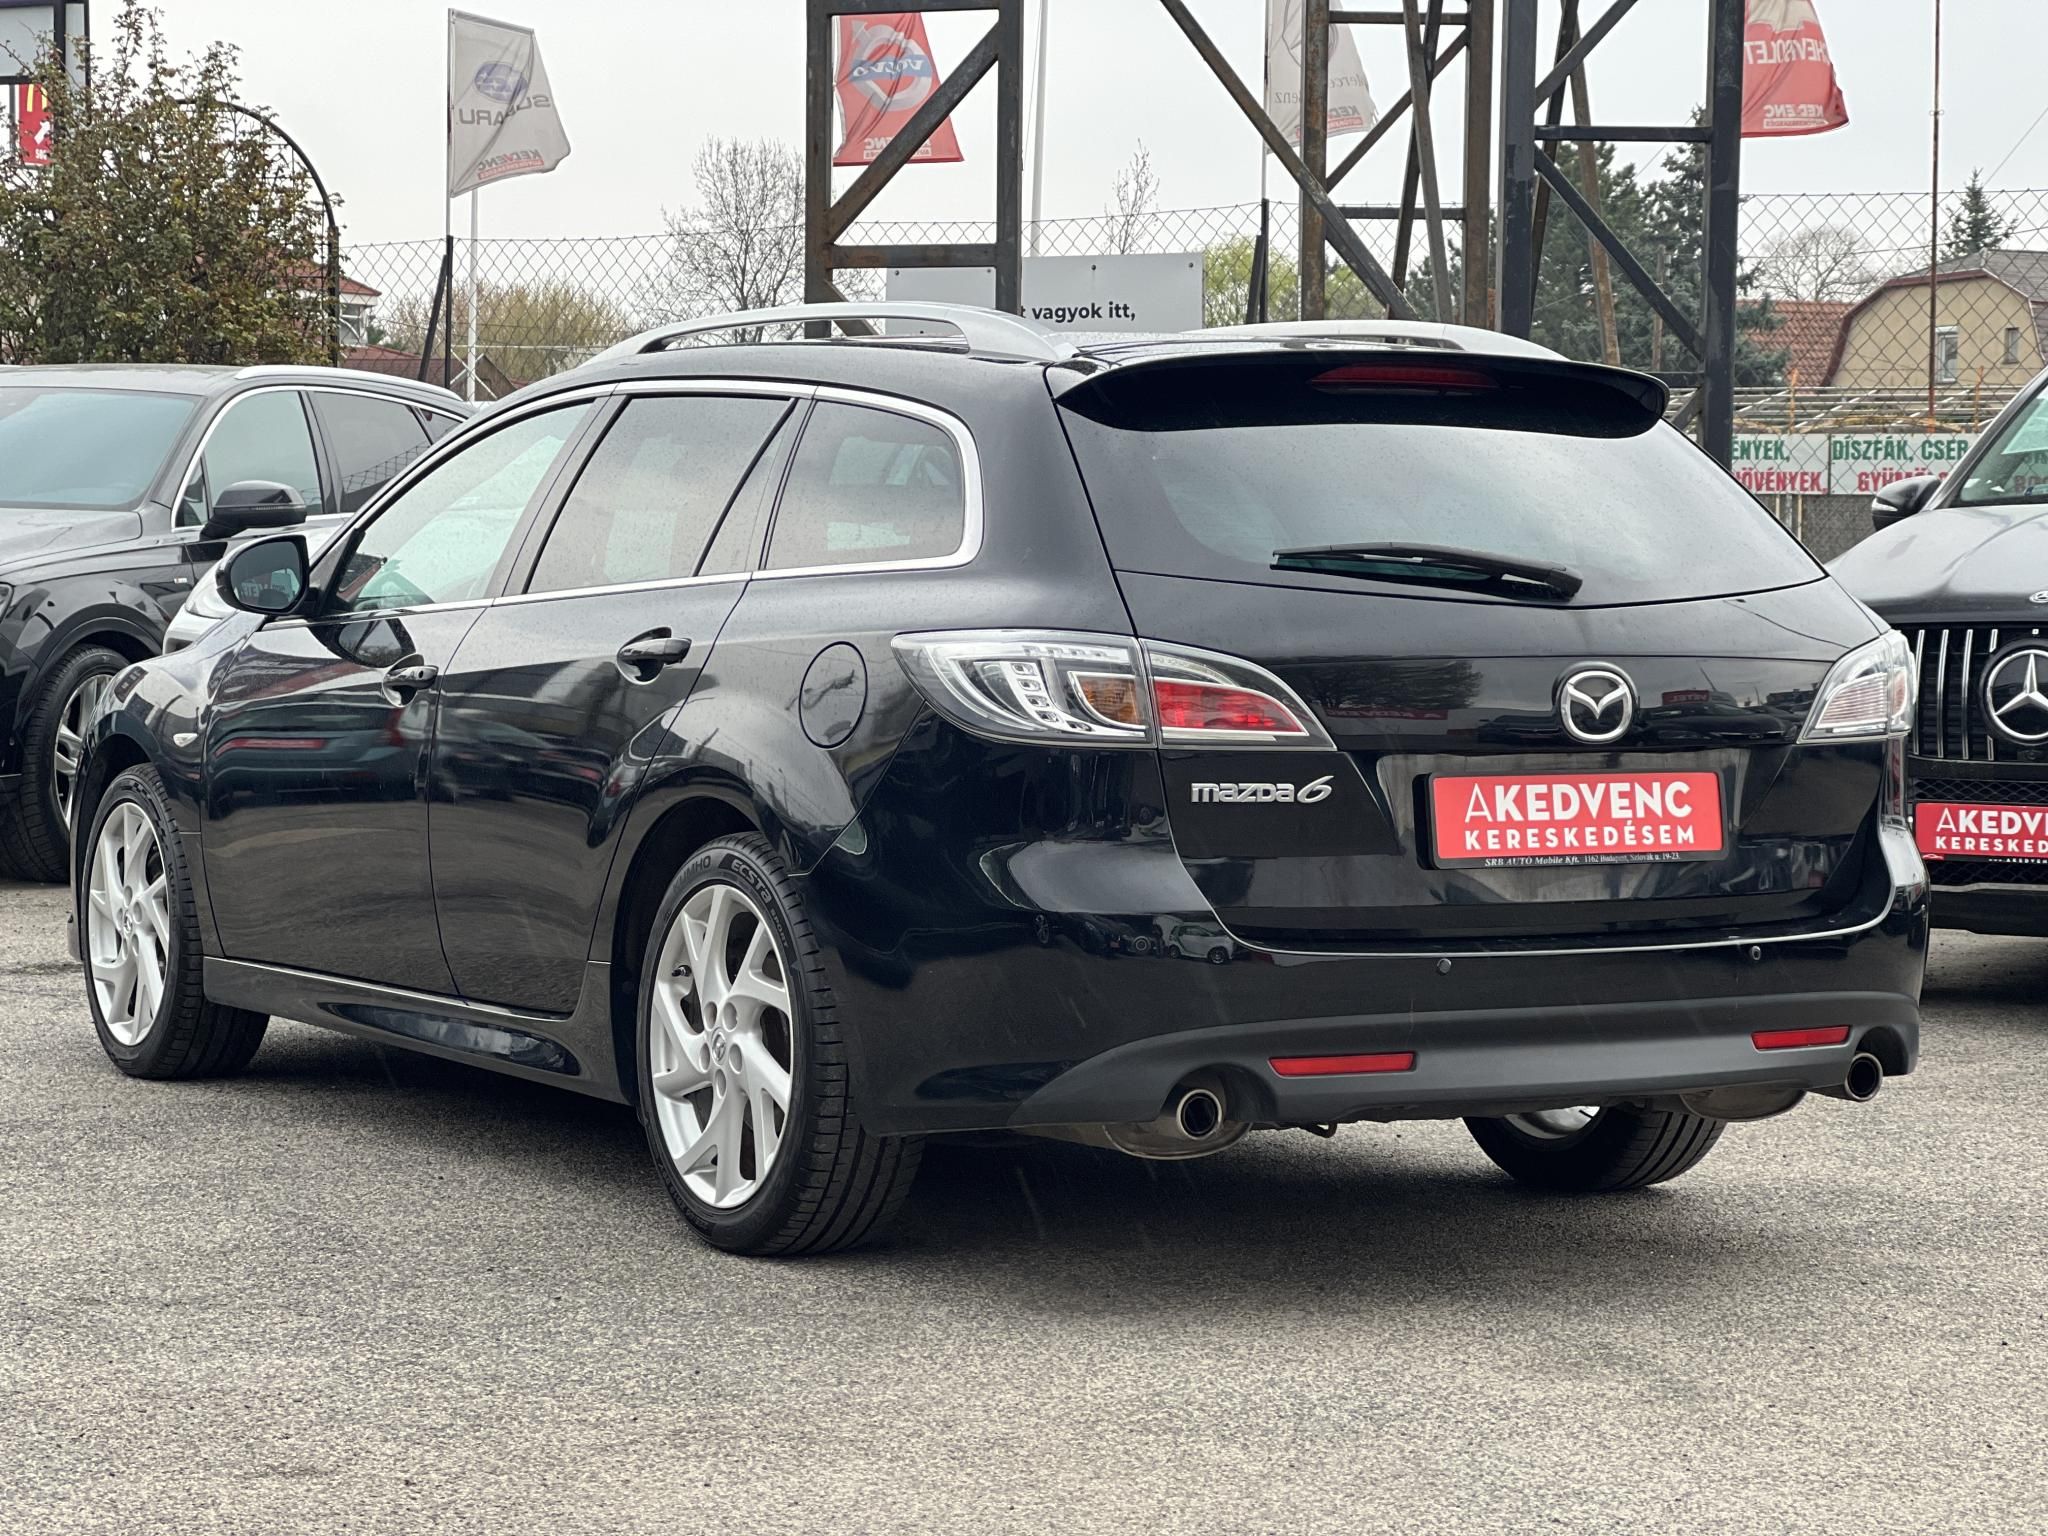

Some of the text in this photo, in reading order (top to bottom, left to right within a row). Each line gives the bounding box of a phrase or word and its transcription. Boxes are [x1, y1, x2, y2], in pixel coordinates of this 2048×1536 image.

[1032, 302, 1102, 323] vagyok
[1109, 301, 1136, 321] itt,
[1832, 435, 1914, 462] DÍSZFÁK,
[1465, 820, 1695, 850] KERESKEDÉSEM
[1534, 855, 1563, 865] Mobile
[1584, 854, 1599, 863] 1162
